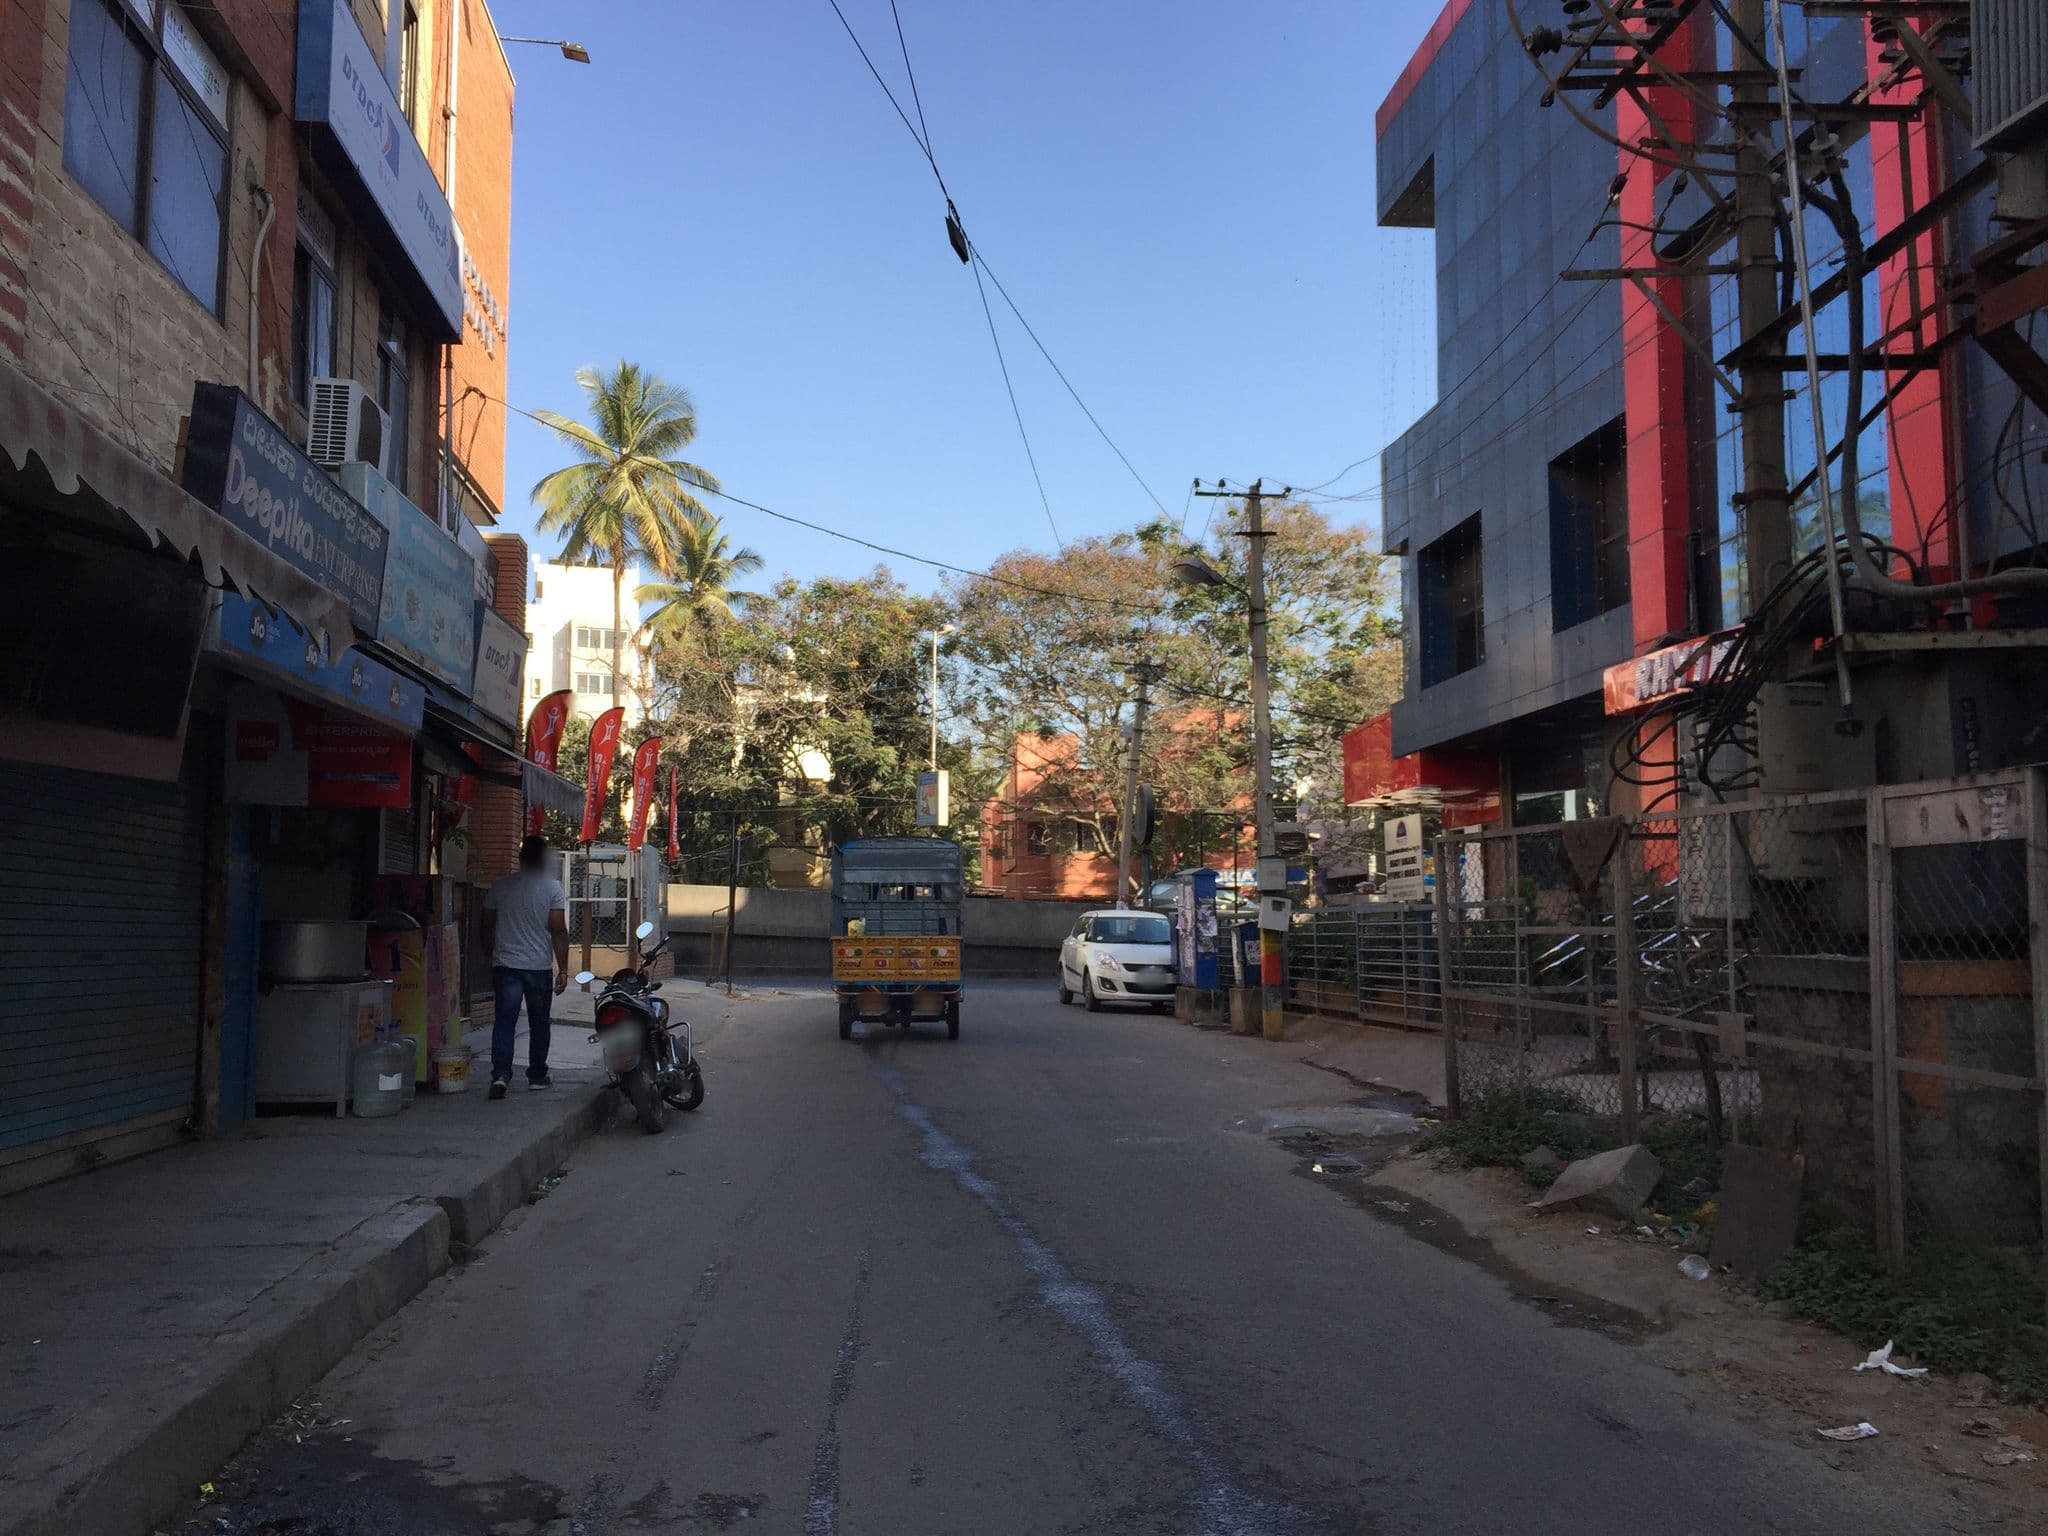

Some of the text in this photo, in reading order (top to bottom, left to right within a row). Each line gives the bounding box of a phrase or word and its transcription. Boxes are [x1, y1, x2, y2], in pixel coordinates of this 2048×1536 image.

[343, 53, 375, 123] DTDC
[417, 191, 442, 244] DTDC
[225, 446, 313, 562] Deepika
[314, 535, 380, 604] ENTERPRISES
[250, 616, 266, 639] Jio
